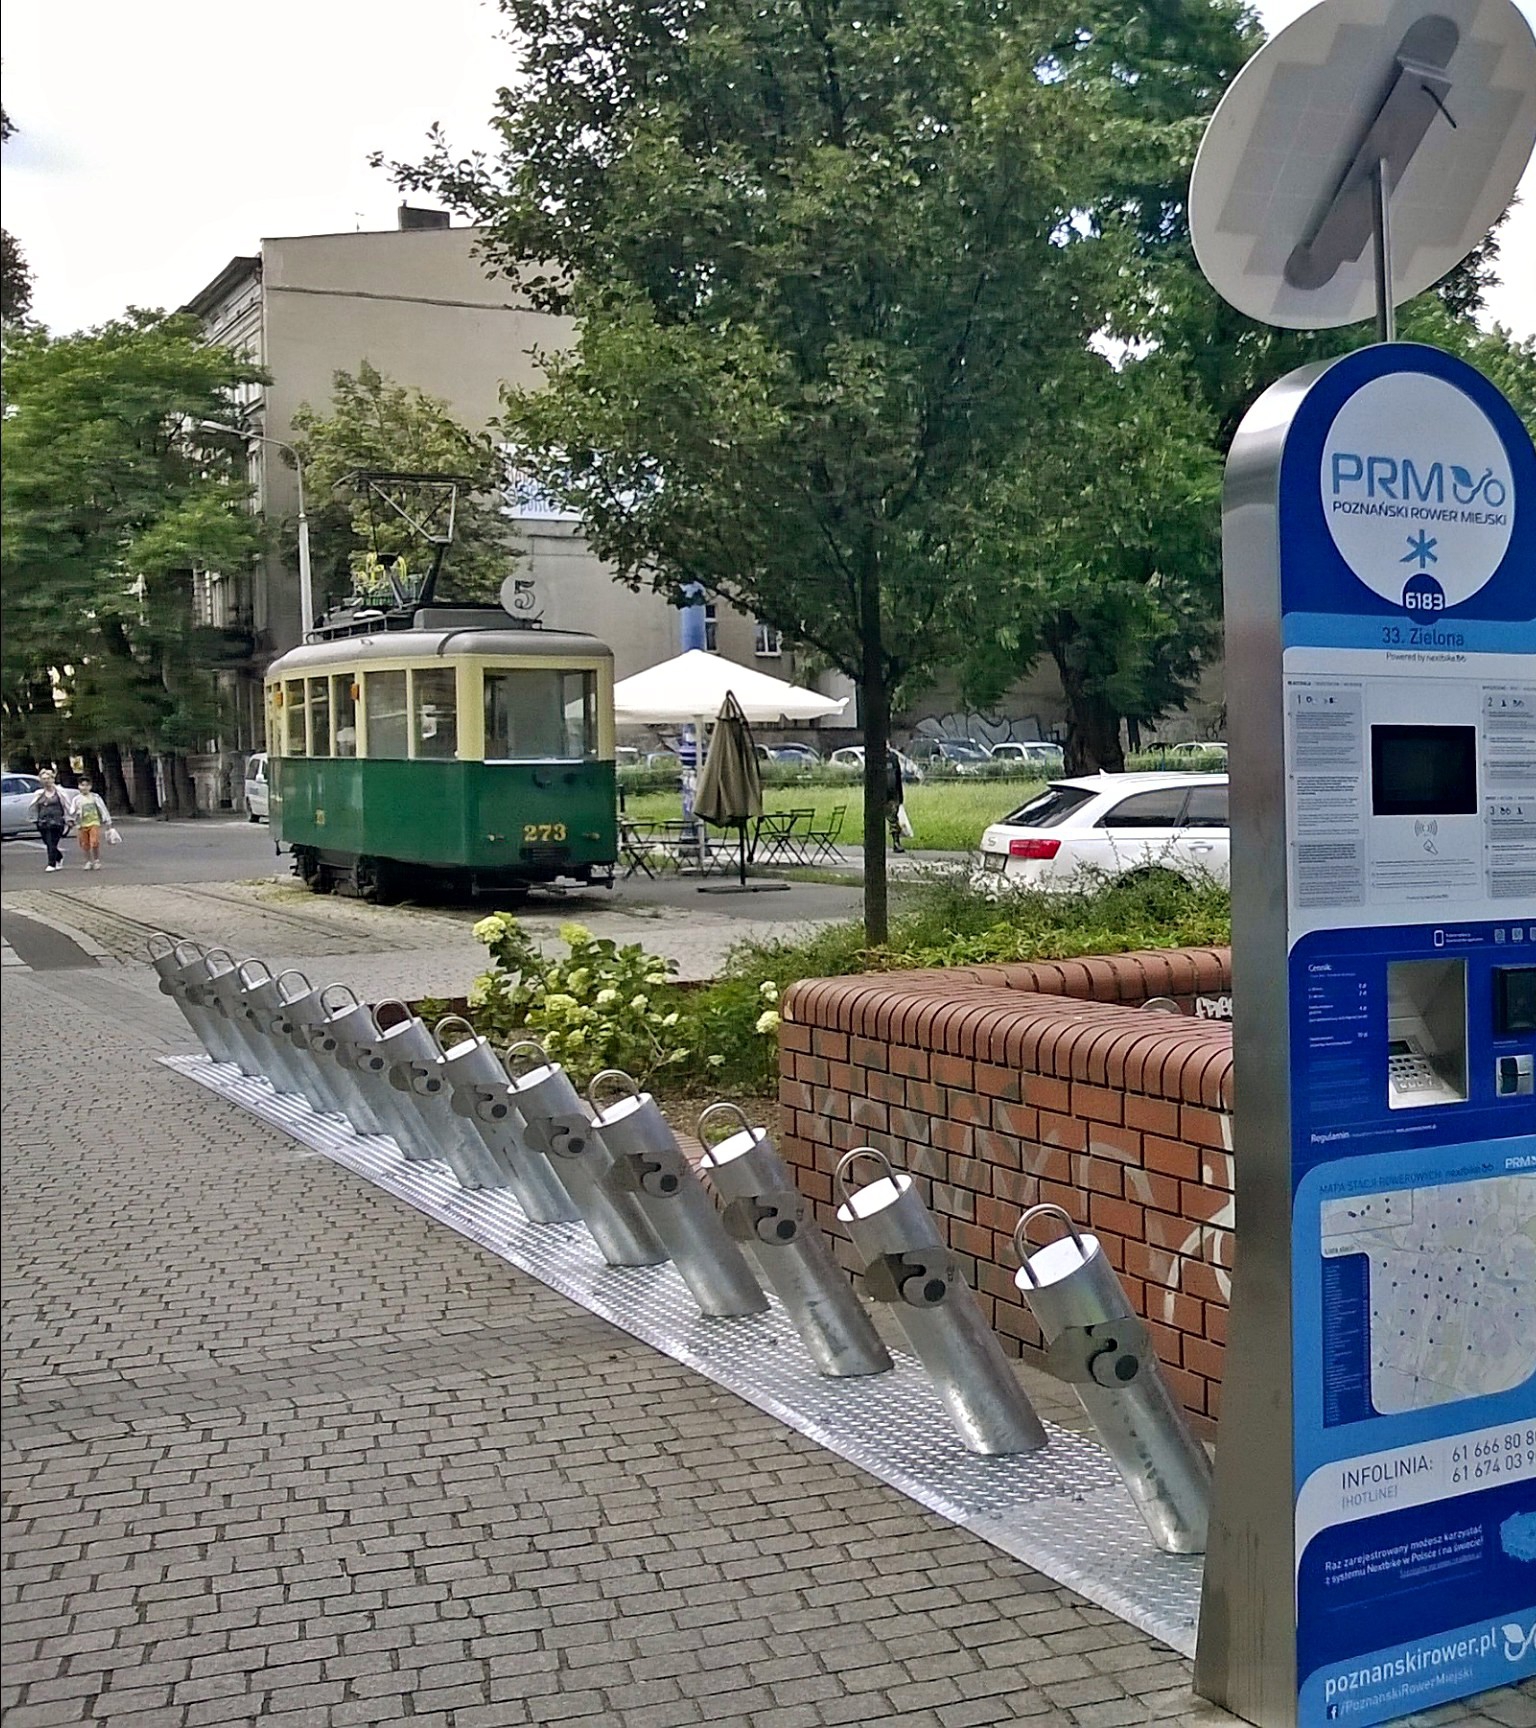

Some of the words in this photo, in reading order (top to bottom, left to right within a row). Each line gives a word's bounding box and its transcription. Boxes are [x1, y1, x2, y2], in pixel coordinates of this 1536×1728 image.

[1331, 452, 1444, 502] PRM
[1332, 500, 1408, 519] POZNAŃSKI
[1410, 506, 1458, 523] ROWER
[1460, 511, 1507, 526] MIEJSKI
[513, 579, 536, 610] 5
[1405, 592, 1444, 611] 6183
[1382, 626, 1405, 645] 33.
[1409, 627, 1464, 647] Zielona
[1386, 652, 1417, 662] Powered
[523, 823, 567, 842] 273
[1505, 1155, 1531, 1170] PRM
[1341, 1455, 1433, 1490] INFOLINIA:
[1452, 1445, 1468, 1463] 61
[1474, 1437, 1500, 1459] 666
[1504, 1432, 1521, 1450] 80
[1452, 1465, 1469, 1483] 61
[1474, 1457, 1501, 1479] 674
[1505, 1452, 1523, 1471] 03
[1325, 1560, 1342, 1571] Raz
[1343, 1544, 1409, 1569] zarejestrowany
[1410, 1536, 1443, 1549] możesz
[1325, 1627, 1497, 1702] poznanskirower.pl
